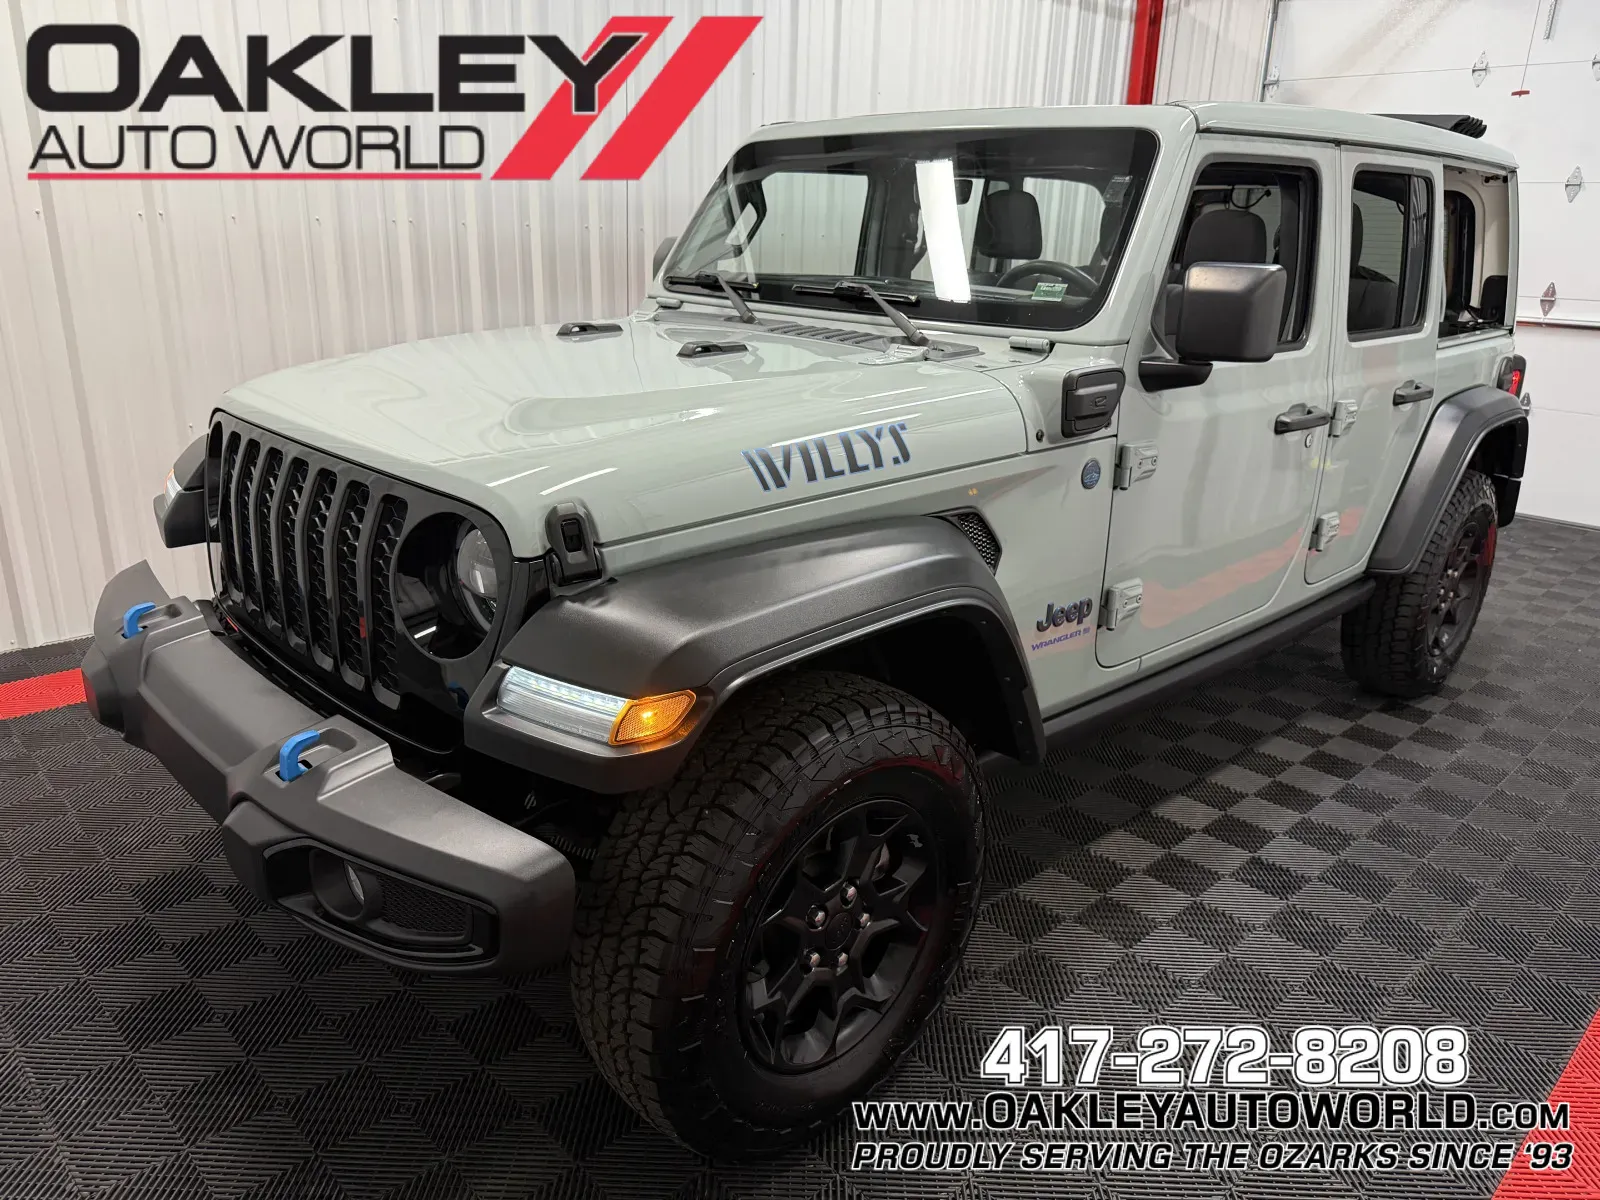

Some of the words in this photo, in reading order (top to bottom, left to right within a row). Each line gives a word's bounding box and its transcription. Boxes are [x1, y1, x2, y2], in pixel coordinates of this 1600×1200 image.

[741, 422, 910, 492] WILLYS
[1036, 597, 1093, 632] Jeep
[1031, 630, 1082, 651] WRANGLER
